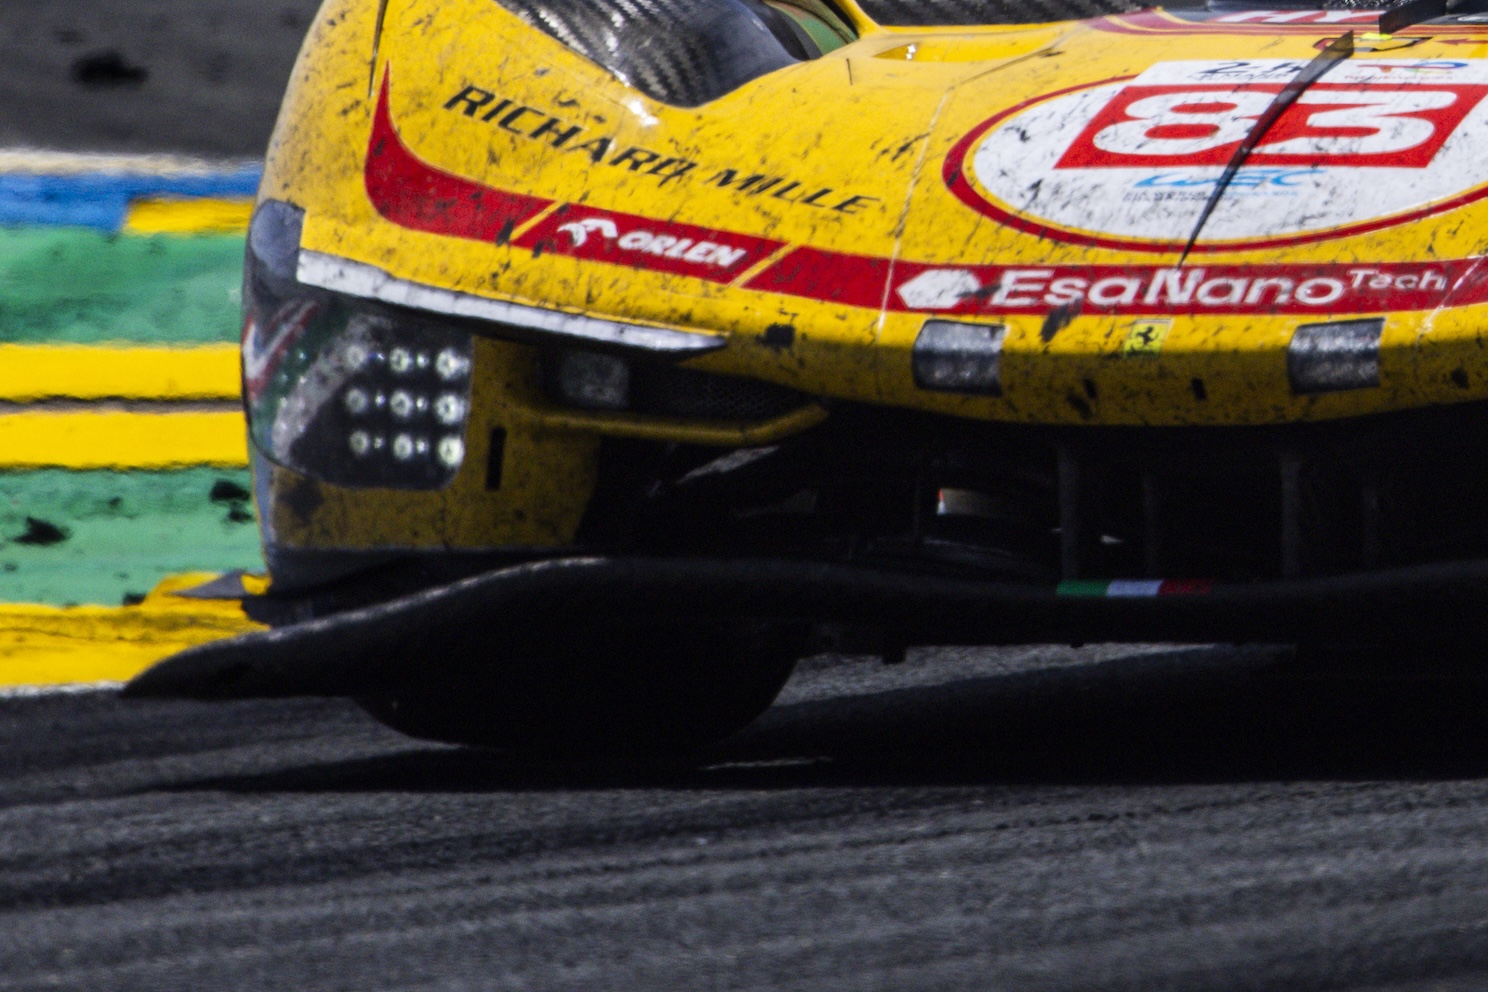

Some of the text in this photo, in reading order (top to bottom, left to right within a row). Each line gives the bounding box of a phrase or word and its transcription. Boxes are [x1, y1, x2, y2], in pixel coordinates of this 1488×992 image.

[1092, 90, 1458, 156] 83
[443, 84, 882, 216] RICHARD MILLE
[618, 229, 747, 268] ORLEN
[990, 267, 1450, 307] EsaNano Tech
